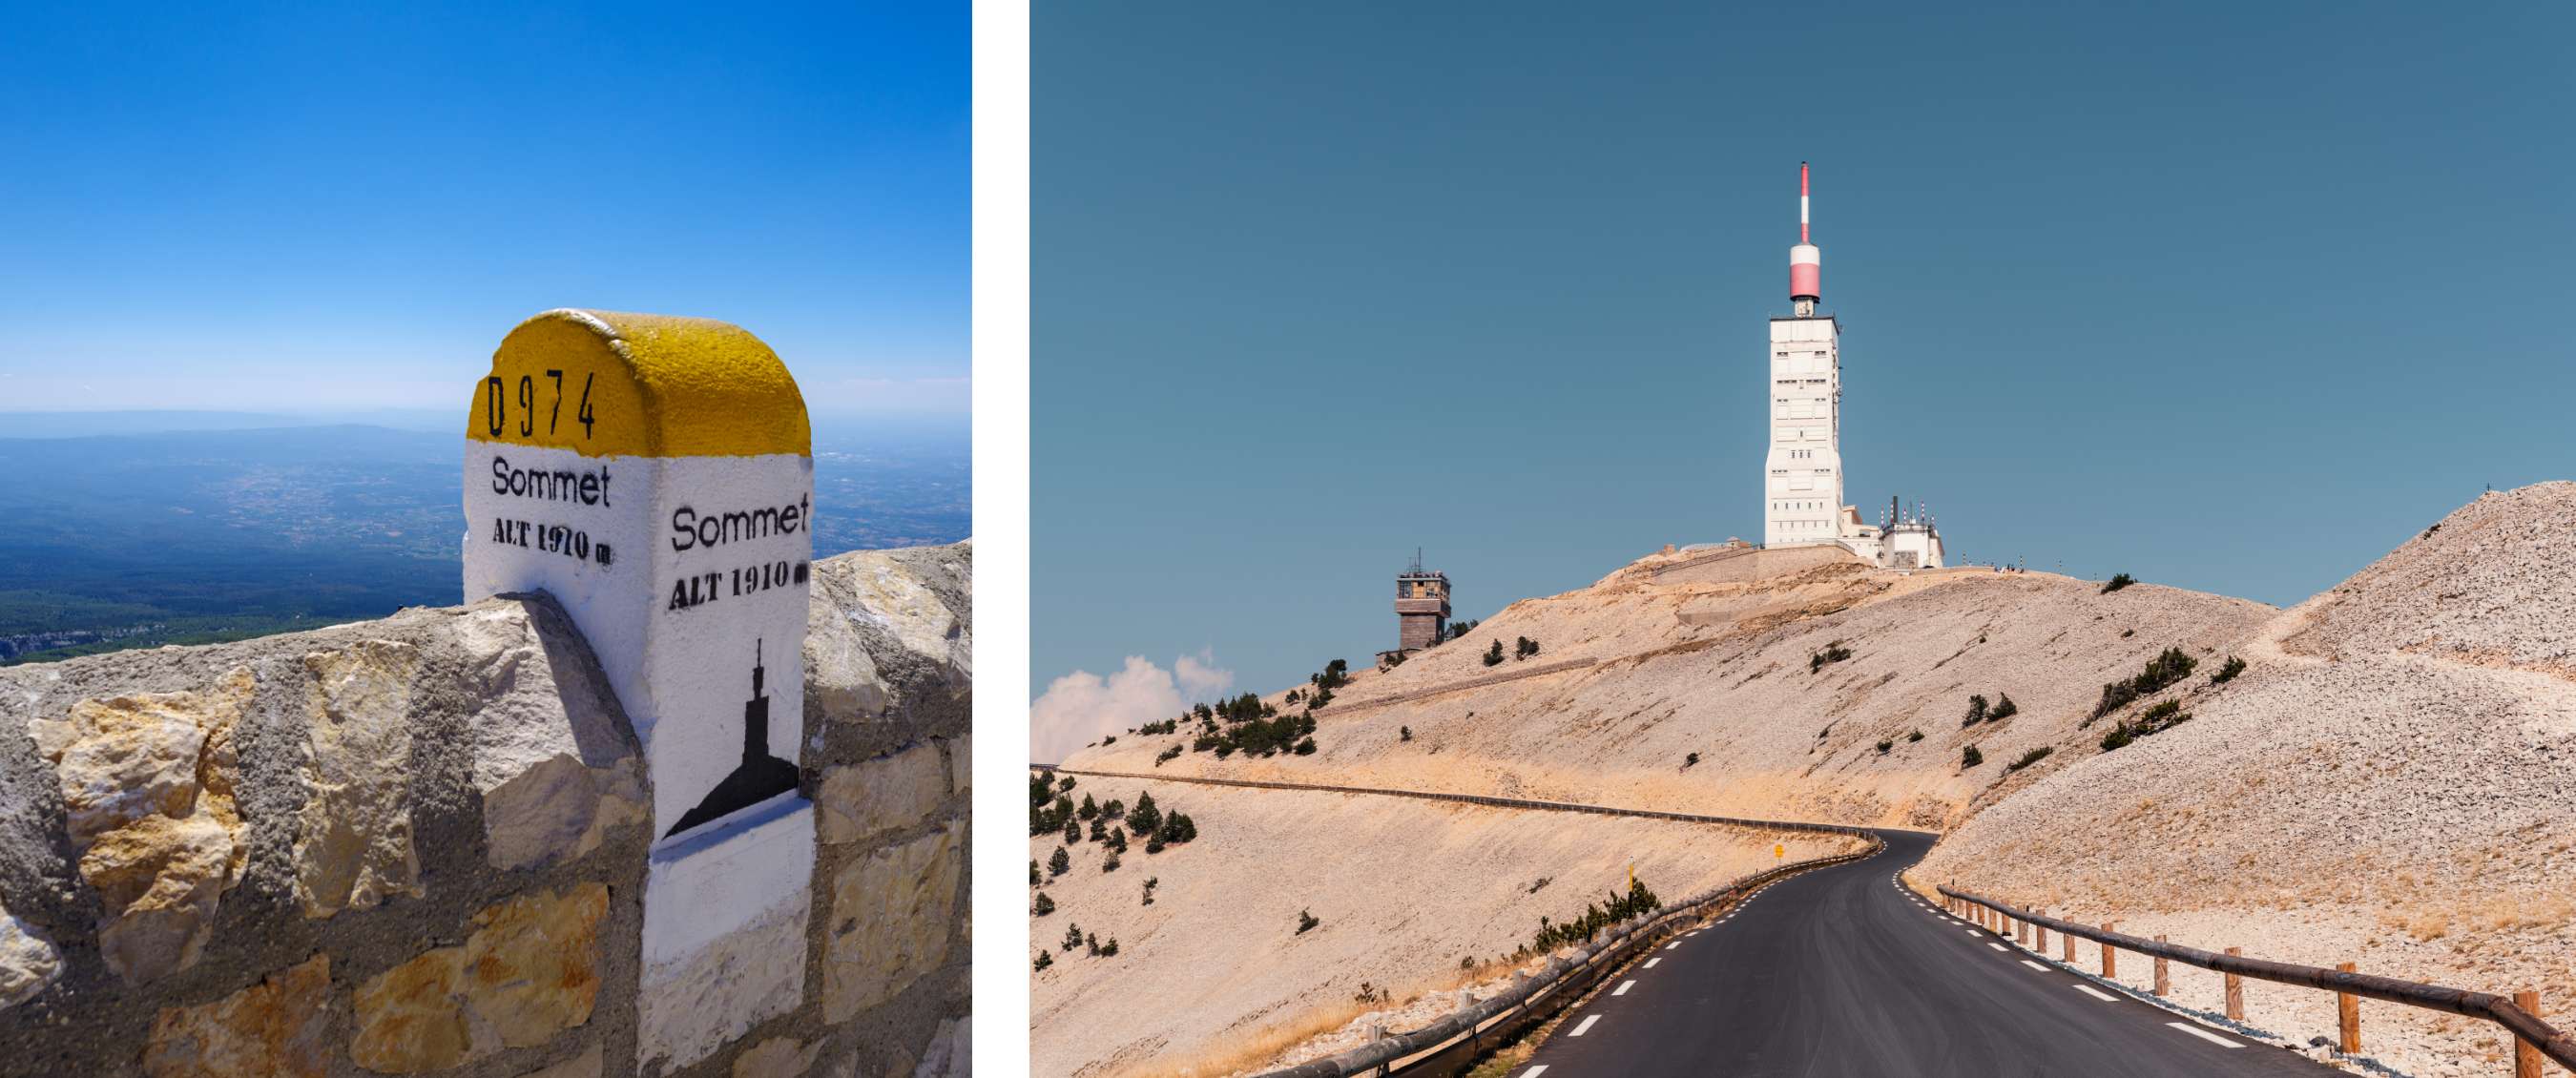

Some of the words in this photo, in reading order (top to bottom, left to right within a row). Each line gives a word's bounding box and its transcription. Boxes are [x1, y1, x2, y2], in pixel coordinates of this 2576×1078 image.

[492, 456, 612, 508] Sommet
[492, 518, 530, 549] ALT
[672, 492, 809, 551] Sommet
[669, 572, 722, 611] ALT
[732, 561, 789, 597] 1910
